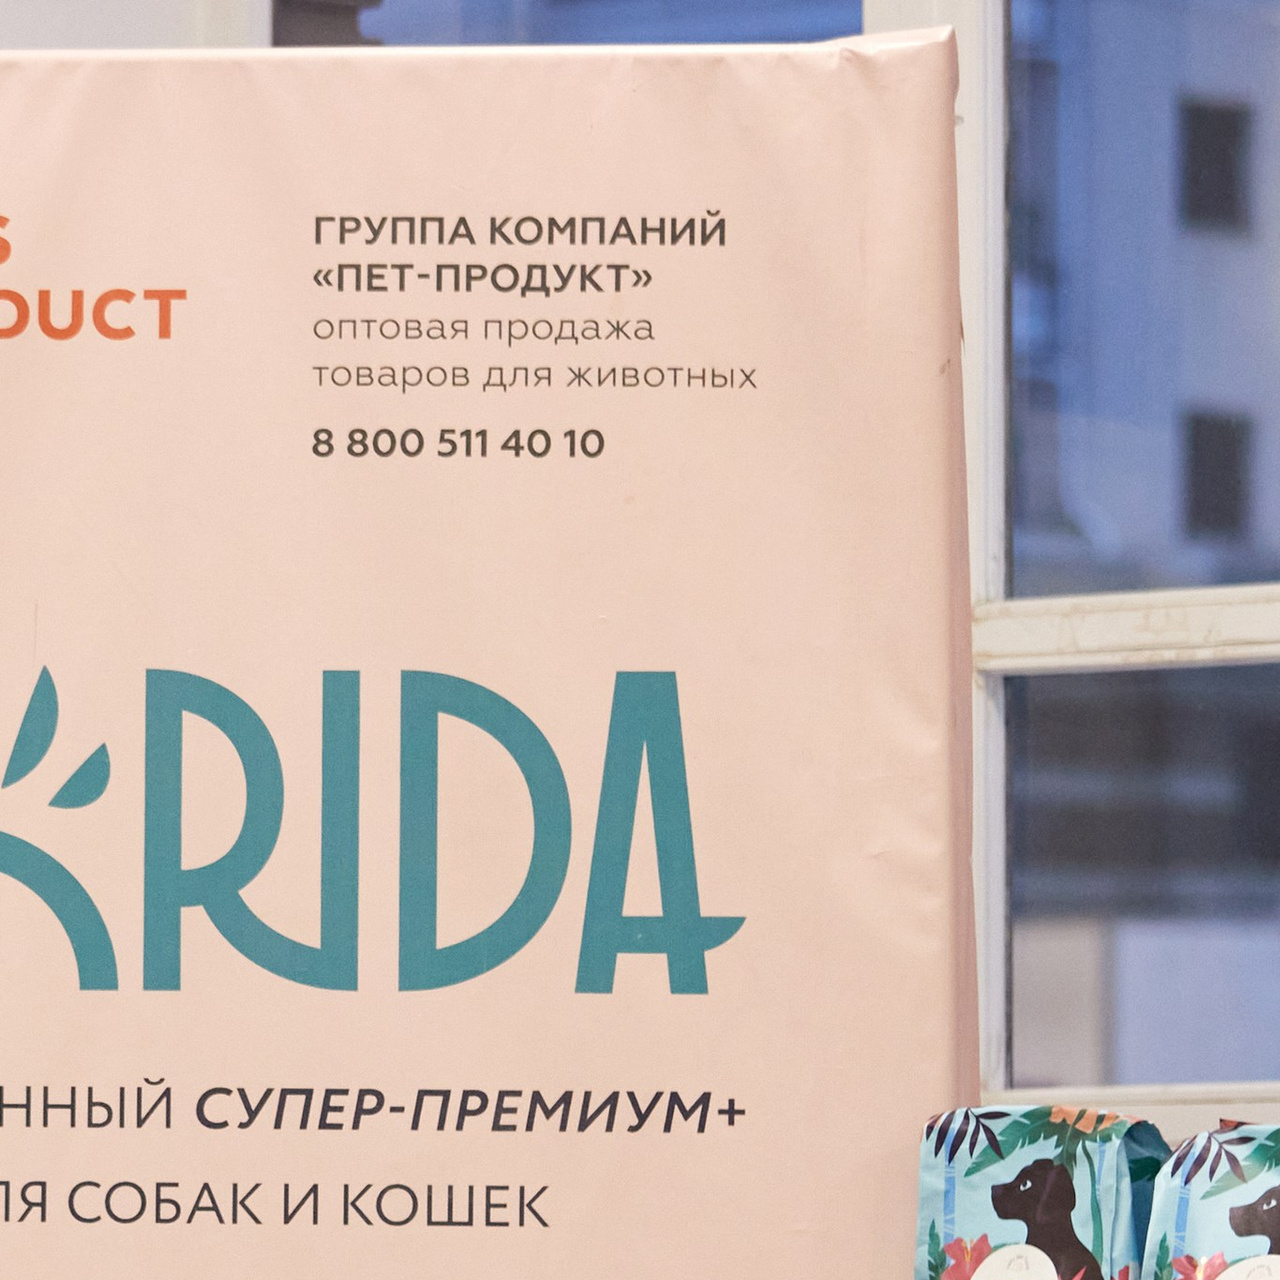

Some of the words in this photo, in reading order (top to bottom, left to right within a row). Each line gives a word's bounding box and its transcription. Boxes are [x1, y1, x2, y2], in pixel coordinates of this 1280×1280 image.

[314, 216, 477, 246] ГРУППА
[489, 209, 726, 247] КОМПАНИЙ
[312, 263, 653, 297] «ПЕТ-ПРОДУКТ»
[313, 318, 469, 340] оптовая
[484, 318, 655, 348] продажа
[312, 365, 470, 394] товаров
[482, 366, 552, 393] для
[566, 366, 757, 389] животных
[311, 428, 335, 458] 8
[346, 427, 425, 458] 800
[437, 428, 488, 458] 511
[500, 428, 552, 459] 40
[563, 428, 605, 459] 10
[195, 1086, 746, 1134] СУПЕР-ПРЕМИУМ+
[67, 1180, 263, 1225] СОБАК
[283, 1182, 319, 1226] И
[342, 1183, 550, 1228] КОШЕК
